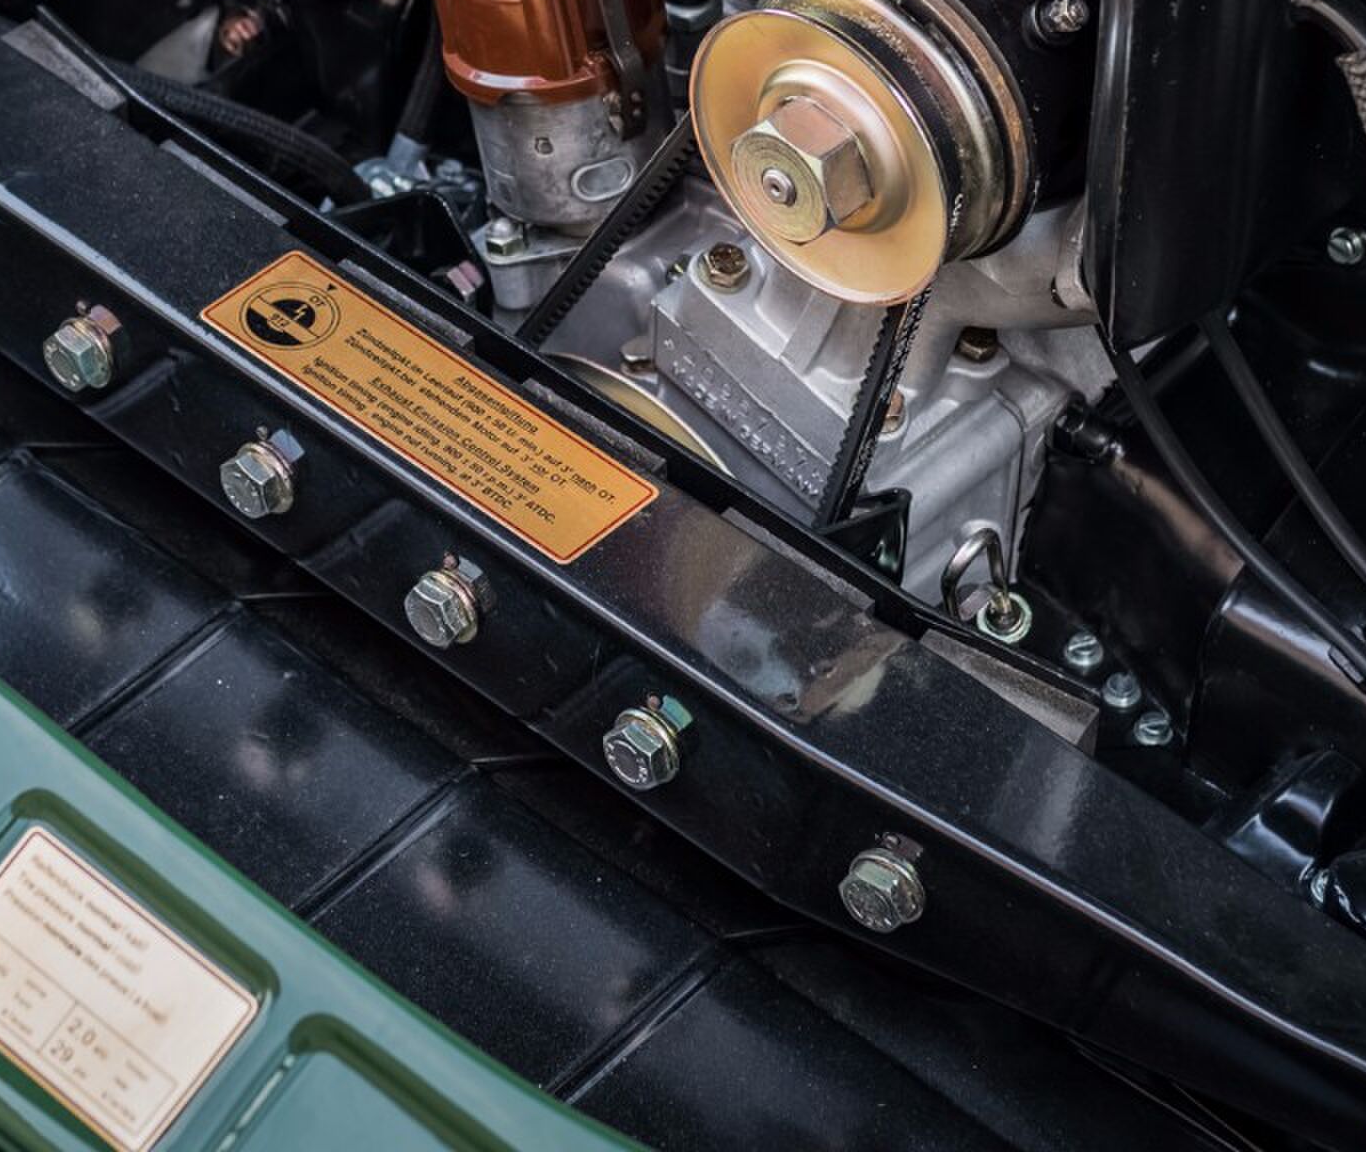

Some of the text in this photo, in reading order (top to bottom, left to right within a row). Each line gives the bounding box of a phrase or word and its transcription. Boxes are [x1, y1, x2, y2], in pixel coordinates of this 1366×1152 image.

[345, 379, 381, 403] timing
[368, 376, 543, 495] Exhaust Emission Control System
[368, 411, 406, 437] engine
[457, 471, 473, 482] at
